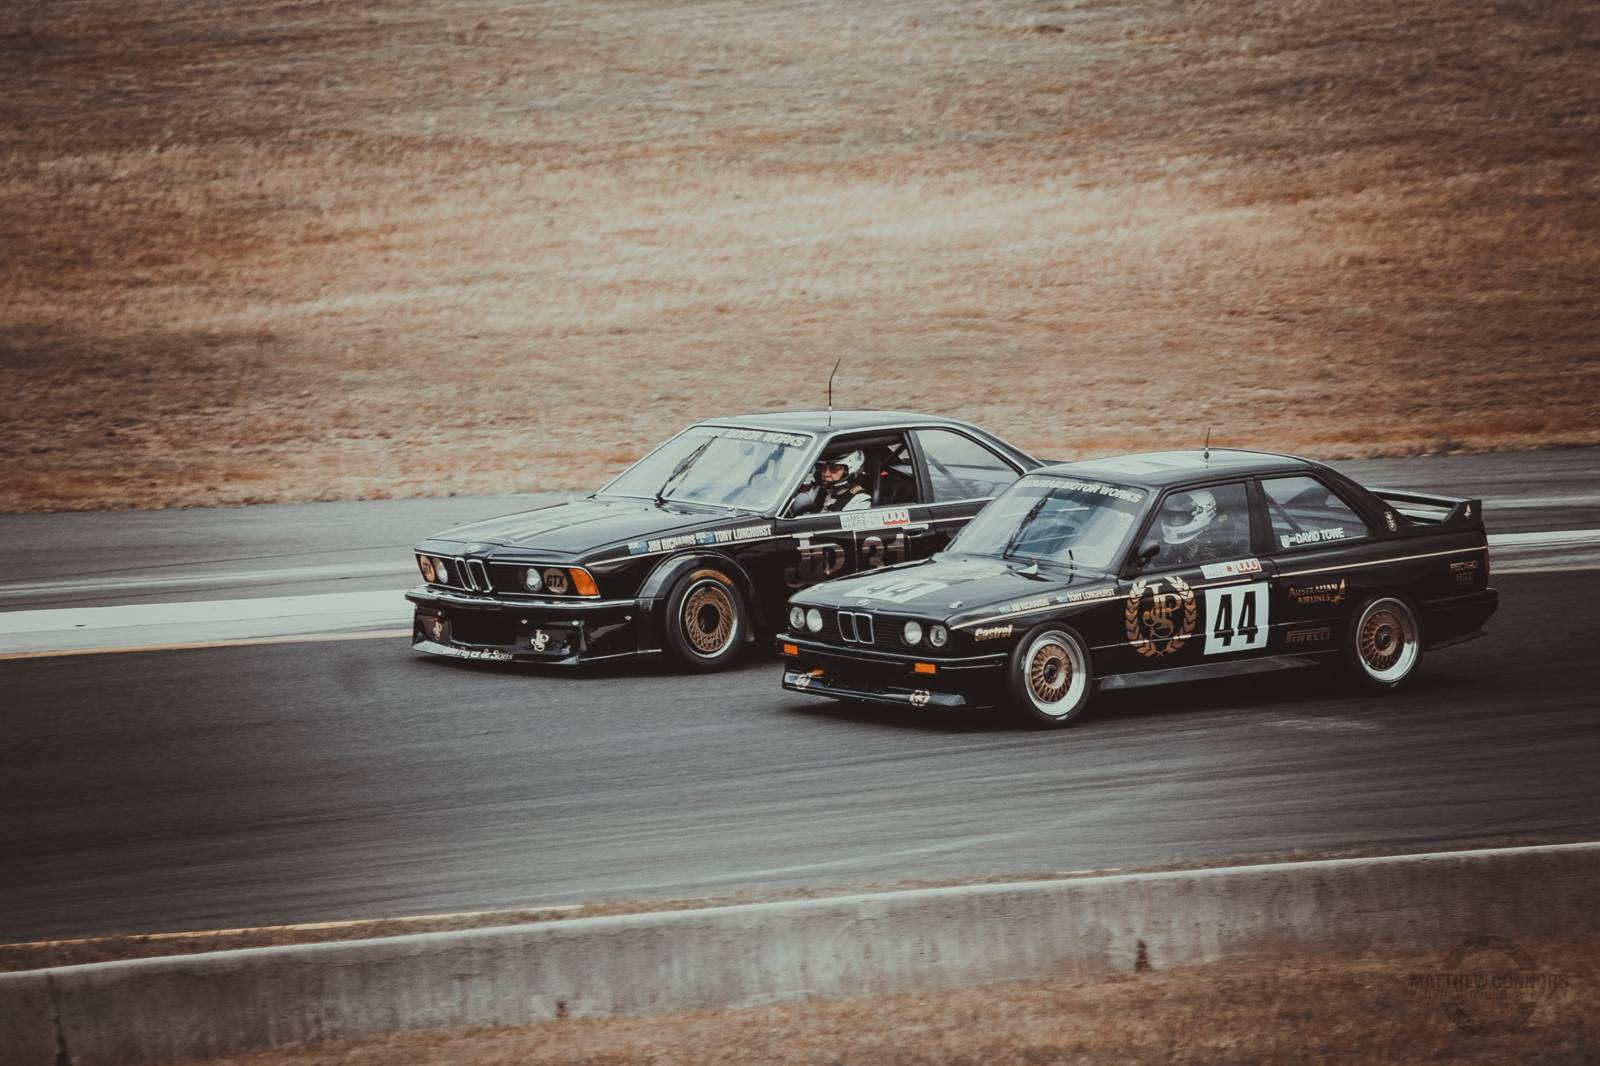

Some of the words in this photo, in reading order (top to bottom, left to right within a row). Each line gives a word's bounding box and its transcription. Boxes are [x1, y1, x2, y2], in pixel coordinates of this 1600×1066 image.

[1061, 480, 1100, 493] MOTOR
[1100, 485, 1143, 503] WORKS
[714, 529, 733, 543] TONY
[733, 525, 772, 540] LONGHURST
[1295, 531, 1320, 545] DAVID
[1320, 527, 1345, 541] TOWE
[647, 540, 662, 552] JIM
[662, 535, 697, 550] RICHARDS
[547, 575, 564, 589] GTX
[1067, 592, 1083, 603] TONY
[1214, 591, 1258, 647] 44
[975, 624, 1013, 642] Castrol
[1286, 626, 1330, 644] PIRELLI
